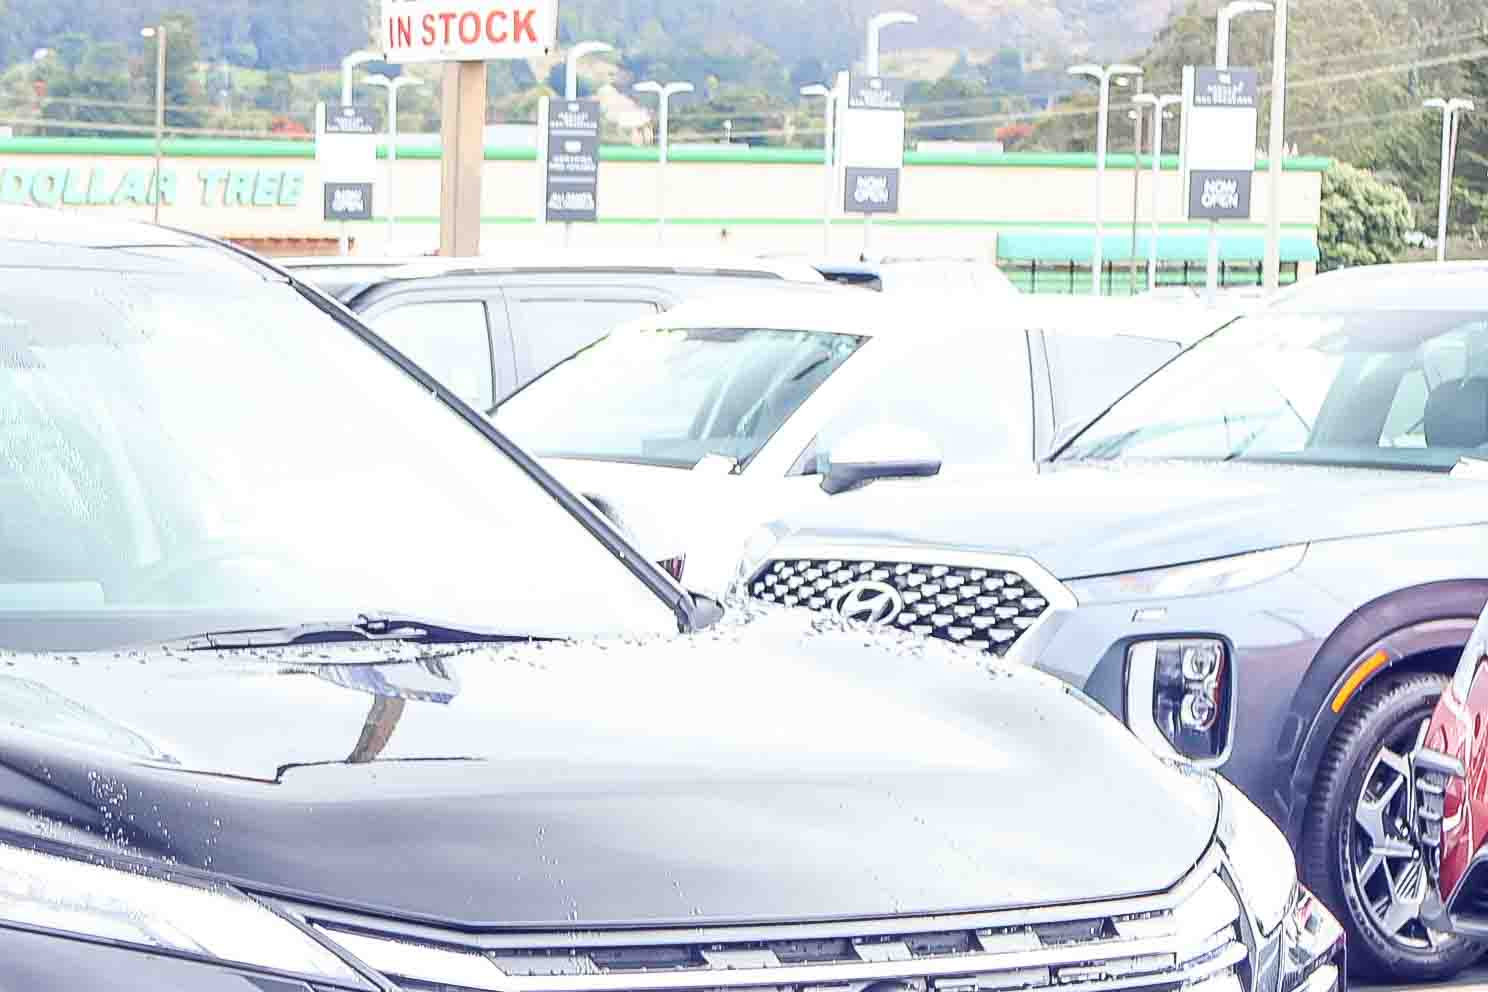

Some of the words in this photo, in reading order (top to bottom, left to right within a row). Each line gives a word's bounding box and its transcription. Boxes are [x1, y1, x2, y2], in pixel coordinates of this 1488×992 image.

[389, 15, 411, 48] IN
[422, 9, 537, 46] STOCK
[197, 169, 305, 206] TREE
[1203, 177, 1238, 193] NOW
[1201, 192, 1240, 208] OPEN
